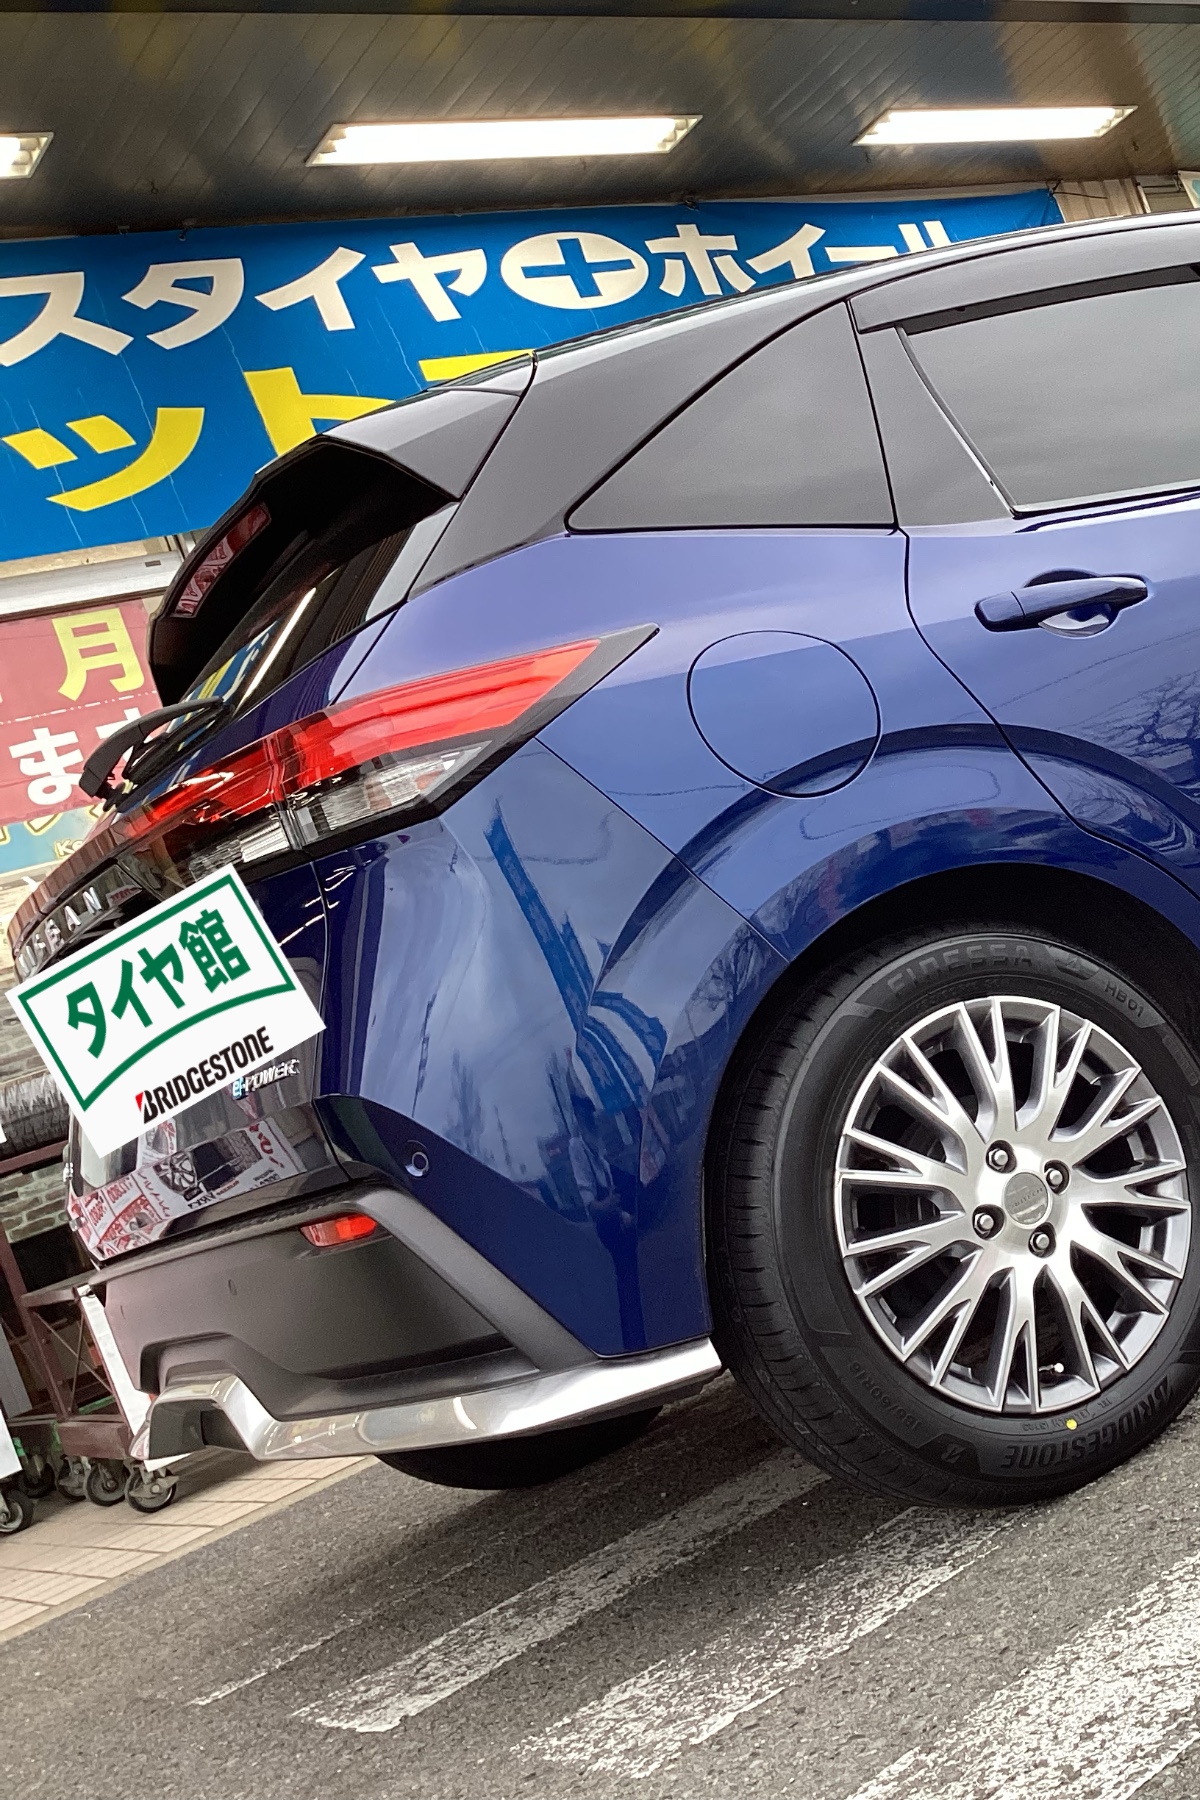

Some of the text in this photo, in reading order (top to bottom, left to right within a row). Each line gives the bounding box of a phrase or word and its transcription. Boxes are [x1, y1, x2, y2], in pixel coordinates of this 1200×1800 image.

[52, 607, 145, 701] 月
[1104, 980, 1146, 1018] HB01
[1000, 1375, 1173, 1470] BRIDGESTONE
